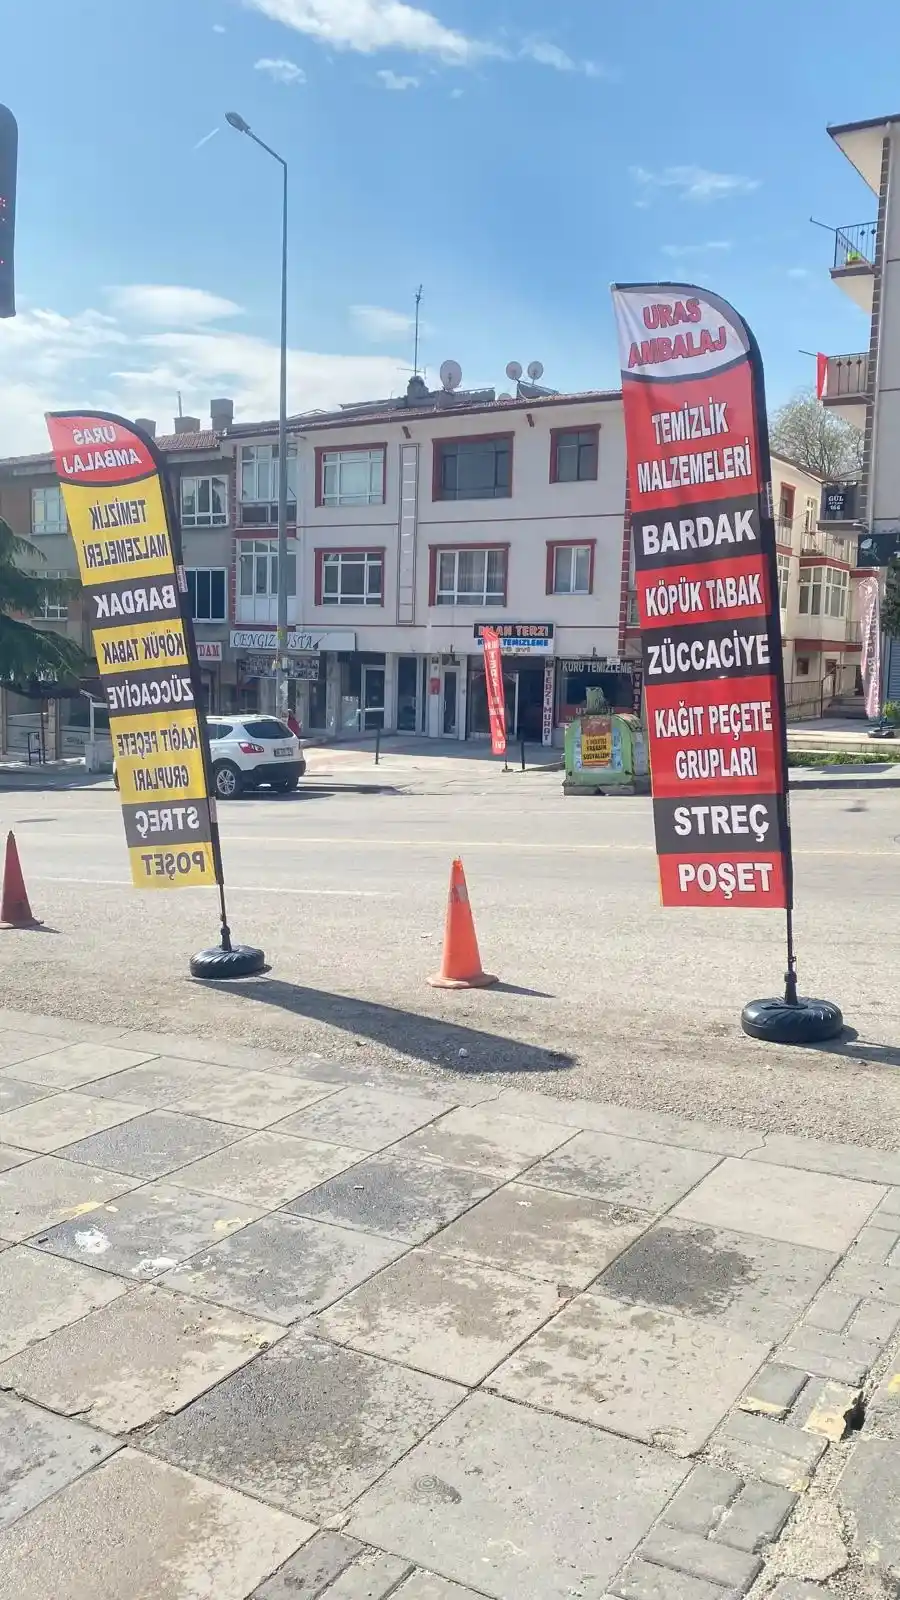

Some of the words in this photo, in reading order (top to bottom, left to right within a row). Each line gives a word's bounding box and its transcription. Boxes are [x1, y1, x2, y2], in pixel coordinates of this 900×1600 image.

[643, 298, 702, 329] URAS
[628, 326, 727, 368] AMBALAJ
[652, 396, 729, 445] TEMİZLİK
[637, 436, 751, 493] MALZEMELERİ
[642, 509, 756, 556] BARDAK
[645, 576, 703, 616] KÖPÜK
[705, 573, 762, 609] TABAK
[287, 633, 313, 649] STA
[647, 629, 771, 675] ZÜCCACİYE
[562, 660, 584, 673] KURU
[655, 701, 704, 738] KAĞIT
[708, 701, 773, 740] PEÇETE
[675, 746, 758, 780] GRUPLARI
[673, 804, 770, 842] STREÇ
[678, 862, 773, 899] POŞET
